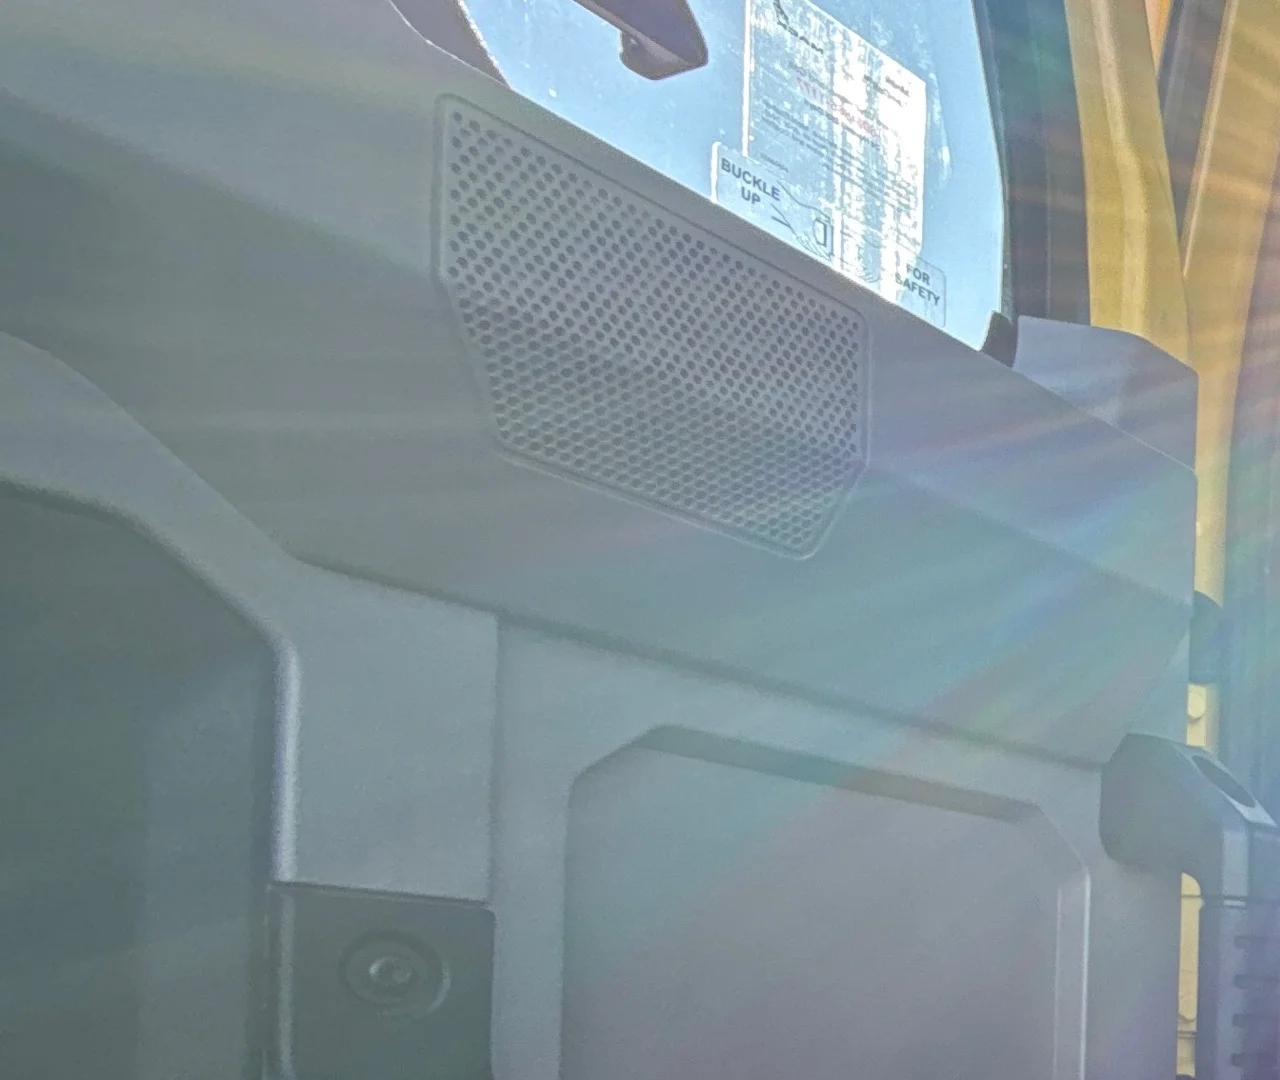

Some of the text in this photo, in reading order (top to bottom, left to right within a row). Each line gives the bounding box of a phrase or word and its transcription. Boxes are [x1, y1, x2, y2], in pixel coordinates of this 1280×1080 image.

[720, 157, 781, 202] BUCKLE
[741, 187, 762, 206] UP
[895, 272, 941, 306] SAFETY
[906, 263, 932, 287] FOR
